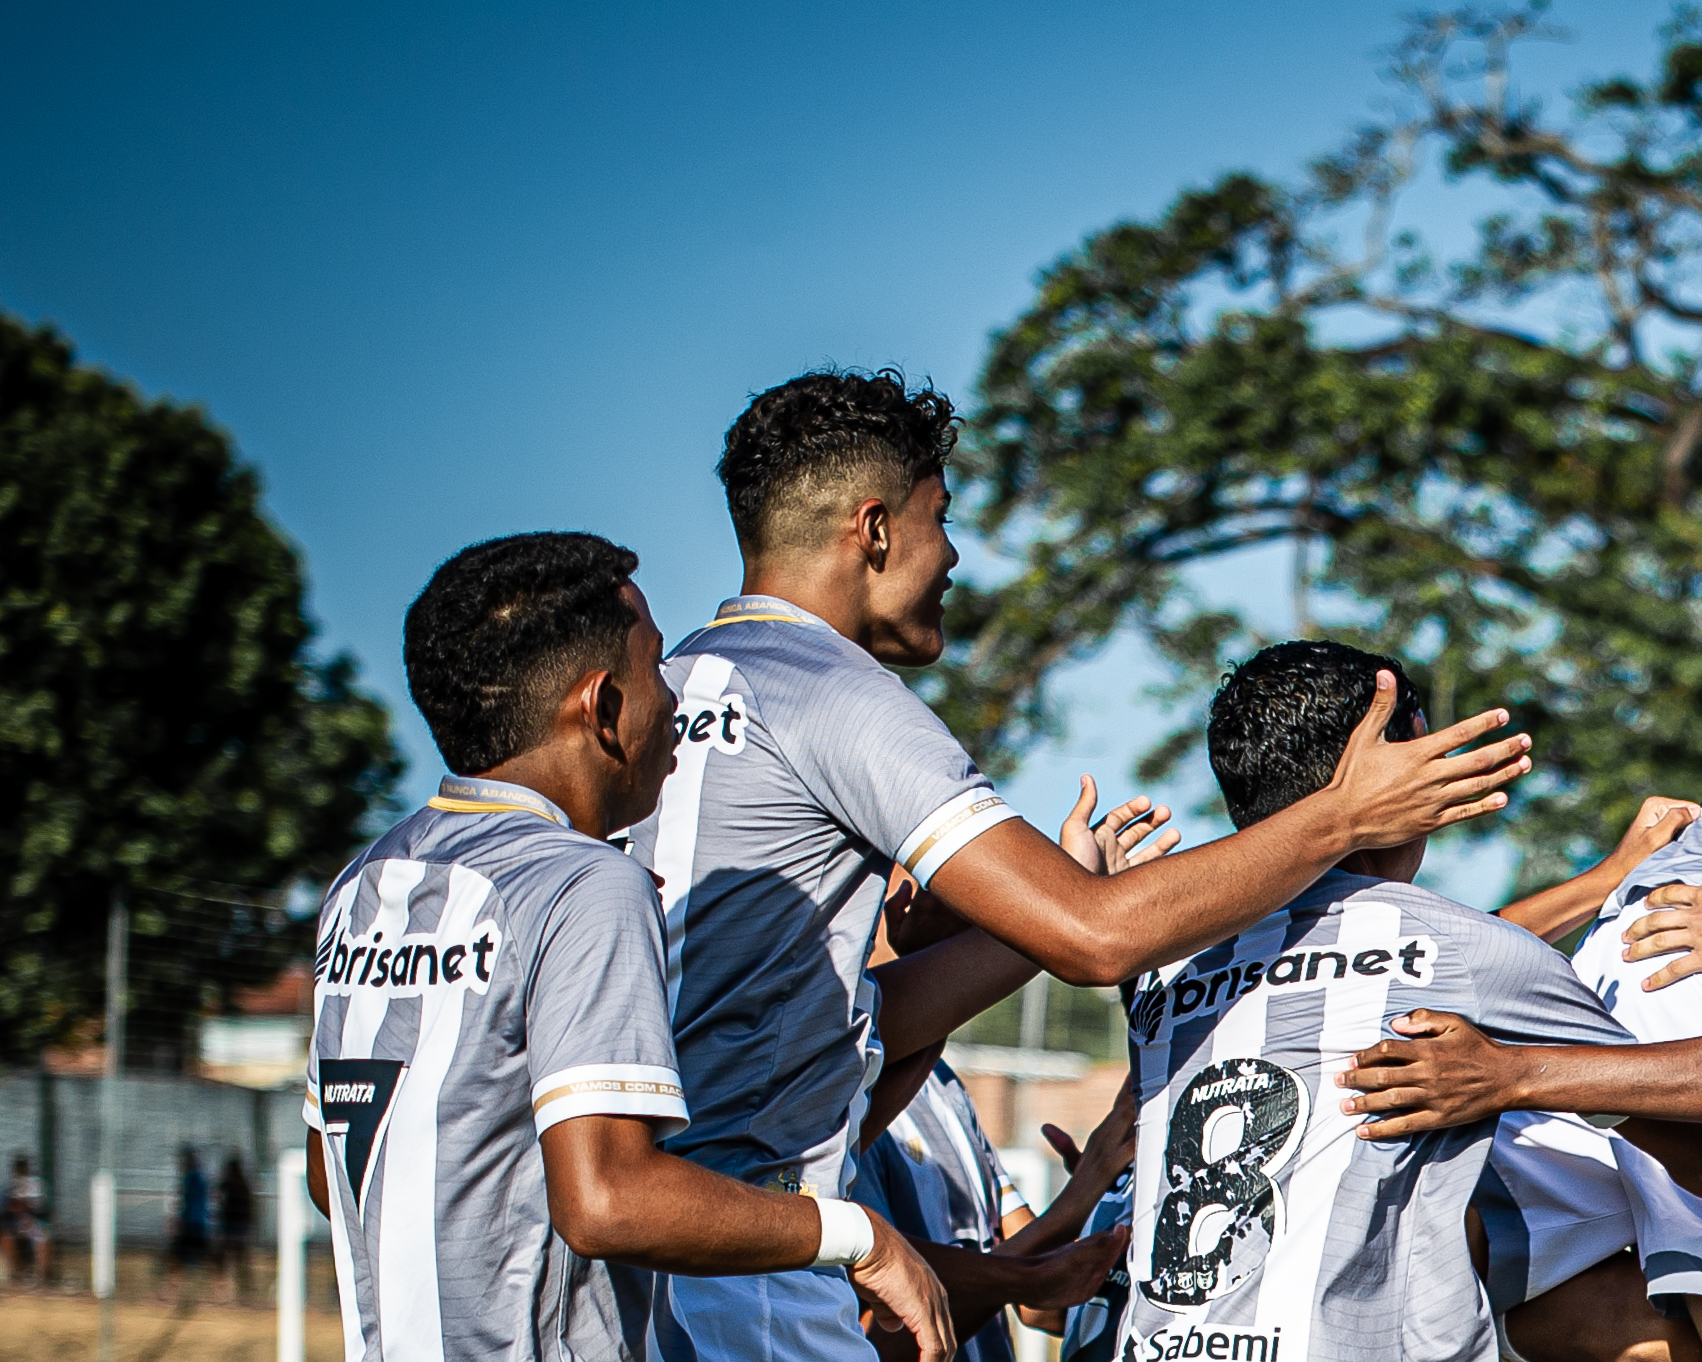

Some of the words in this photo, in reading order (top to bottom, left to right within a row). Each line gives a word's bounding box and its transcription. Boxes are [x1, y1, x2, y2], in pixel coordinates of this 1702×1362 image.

[327, 926, 495, 988] brisanet
[1172, 940, 1427, 1018] brisanet
[324, 1082, 376, 1104] NUTRATA
[569, 1080, 623, 1093] VAMOS
[624, 1082, 657, 1093] COM
[1191, 1072, 1271, 1105] NUTRATA
[319, 1058, 410, 1225] 7
[1140, 1057, 1310, 1313] 8
